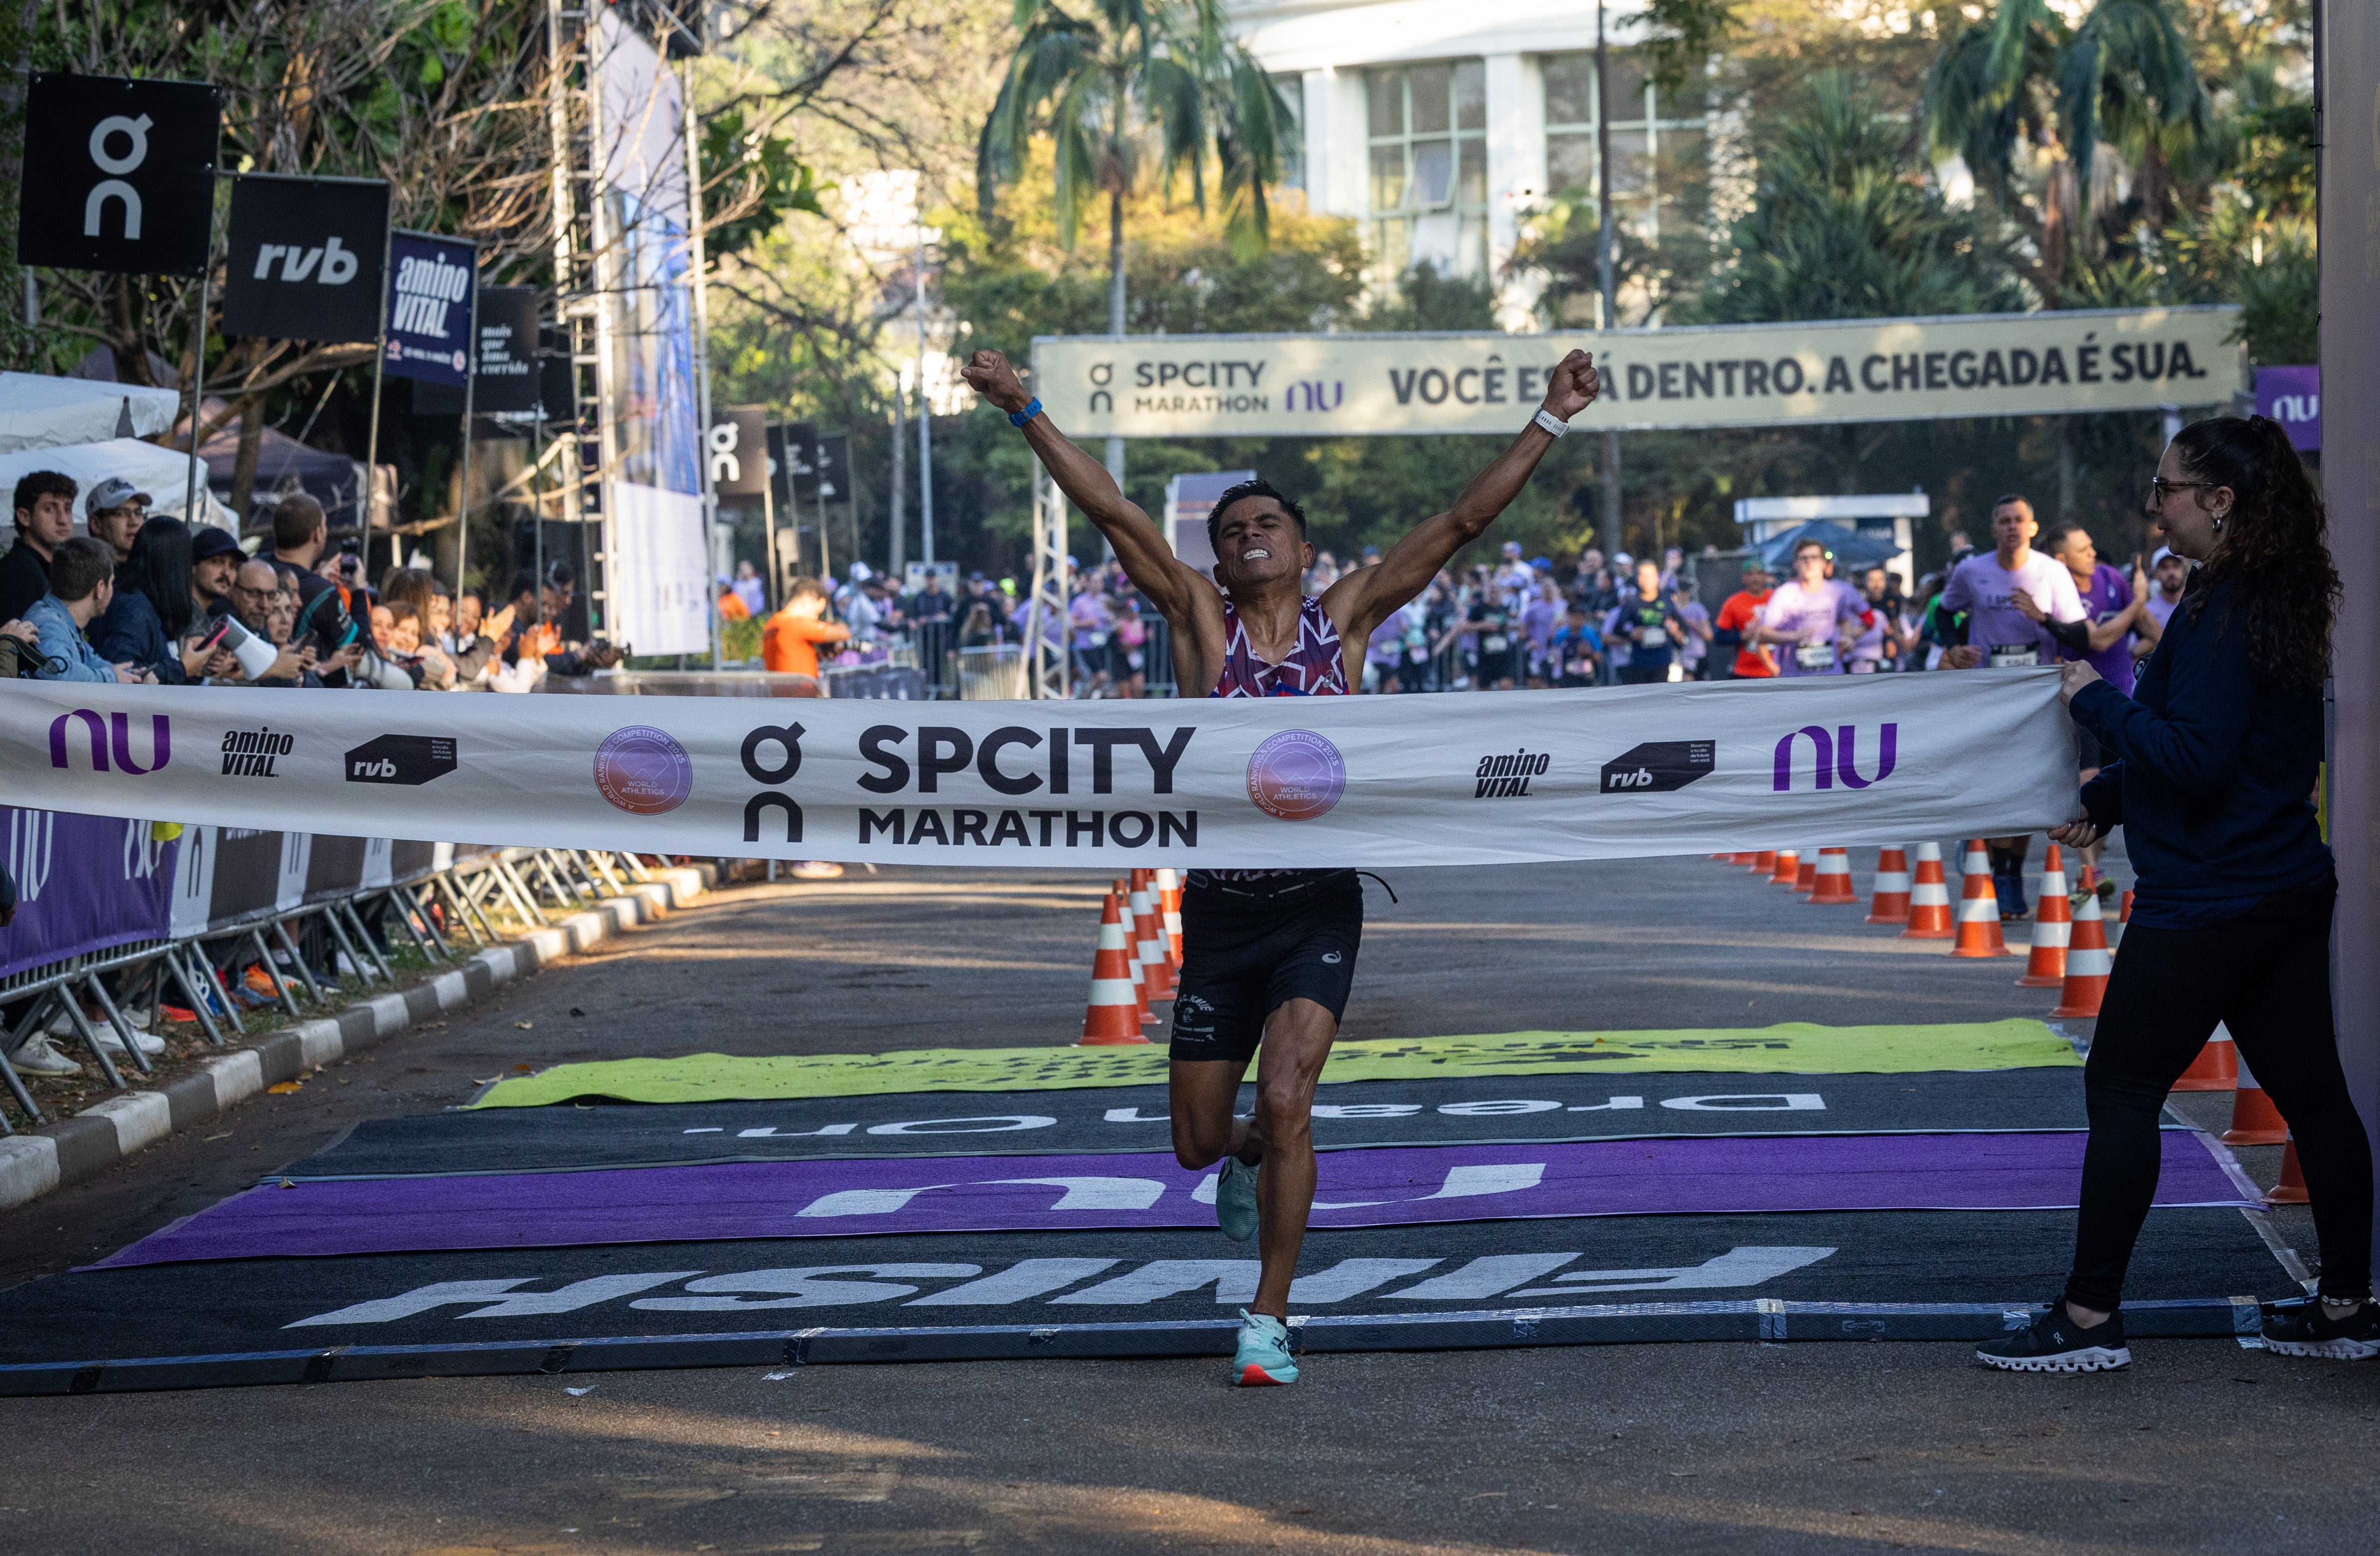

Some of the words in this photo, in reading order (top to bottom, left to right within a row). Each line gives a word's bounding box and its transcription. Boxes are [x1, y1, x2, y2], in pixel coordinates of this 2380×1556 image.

[254, 237, 358, 285] rvb
[396, 252, 469, 303] amino
[393, 293, 449, 338] VITAL
[1390, 354, 1506, 405] VOCÊ
[1627, 358, 1815, 401] DENTRO.
[1824, 356, 1854, 393] A
[1861, 347, 2073, 392] CHEGADA
[2077, 333, 2101, 382] É
[2111, 341, 2206, 381] SUA.
[1135, 395, 1268, 413] MARATHON
[221, 726, 294, 755] amino
[612, 729, 669, 745] COMPETITION
[1266, 733, 1324, 749] COMPETITION
[222, 753, 276, 777] VITAL
[598, 744, 614, 783] RANKINGS
[668, 743, 686, 764] 2025
[1323, 745, 1340, 766] 2025
[1476, 748, 1550, 778] amino
[354, 758, 397, 777] rvb
[1250, 749, 1267, 792] RANKINGS
[1609, 768, 1653, 788] rvb
[602, 785, 626, 807] WORLD
[1474, 777, 1530, 798] VITAL
[1254, 793, 1277, 815] WORLD
[858, 808, 1197, 848] MARATHON
[279, 1247, 1839, 1329] FINISH
